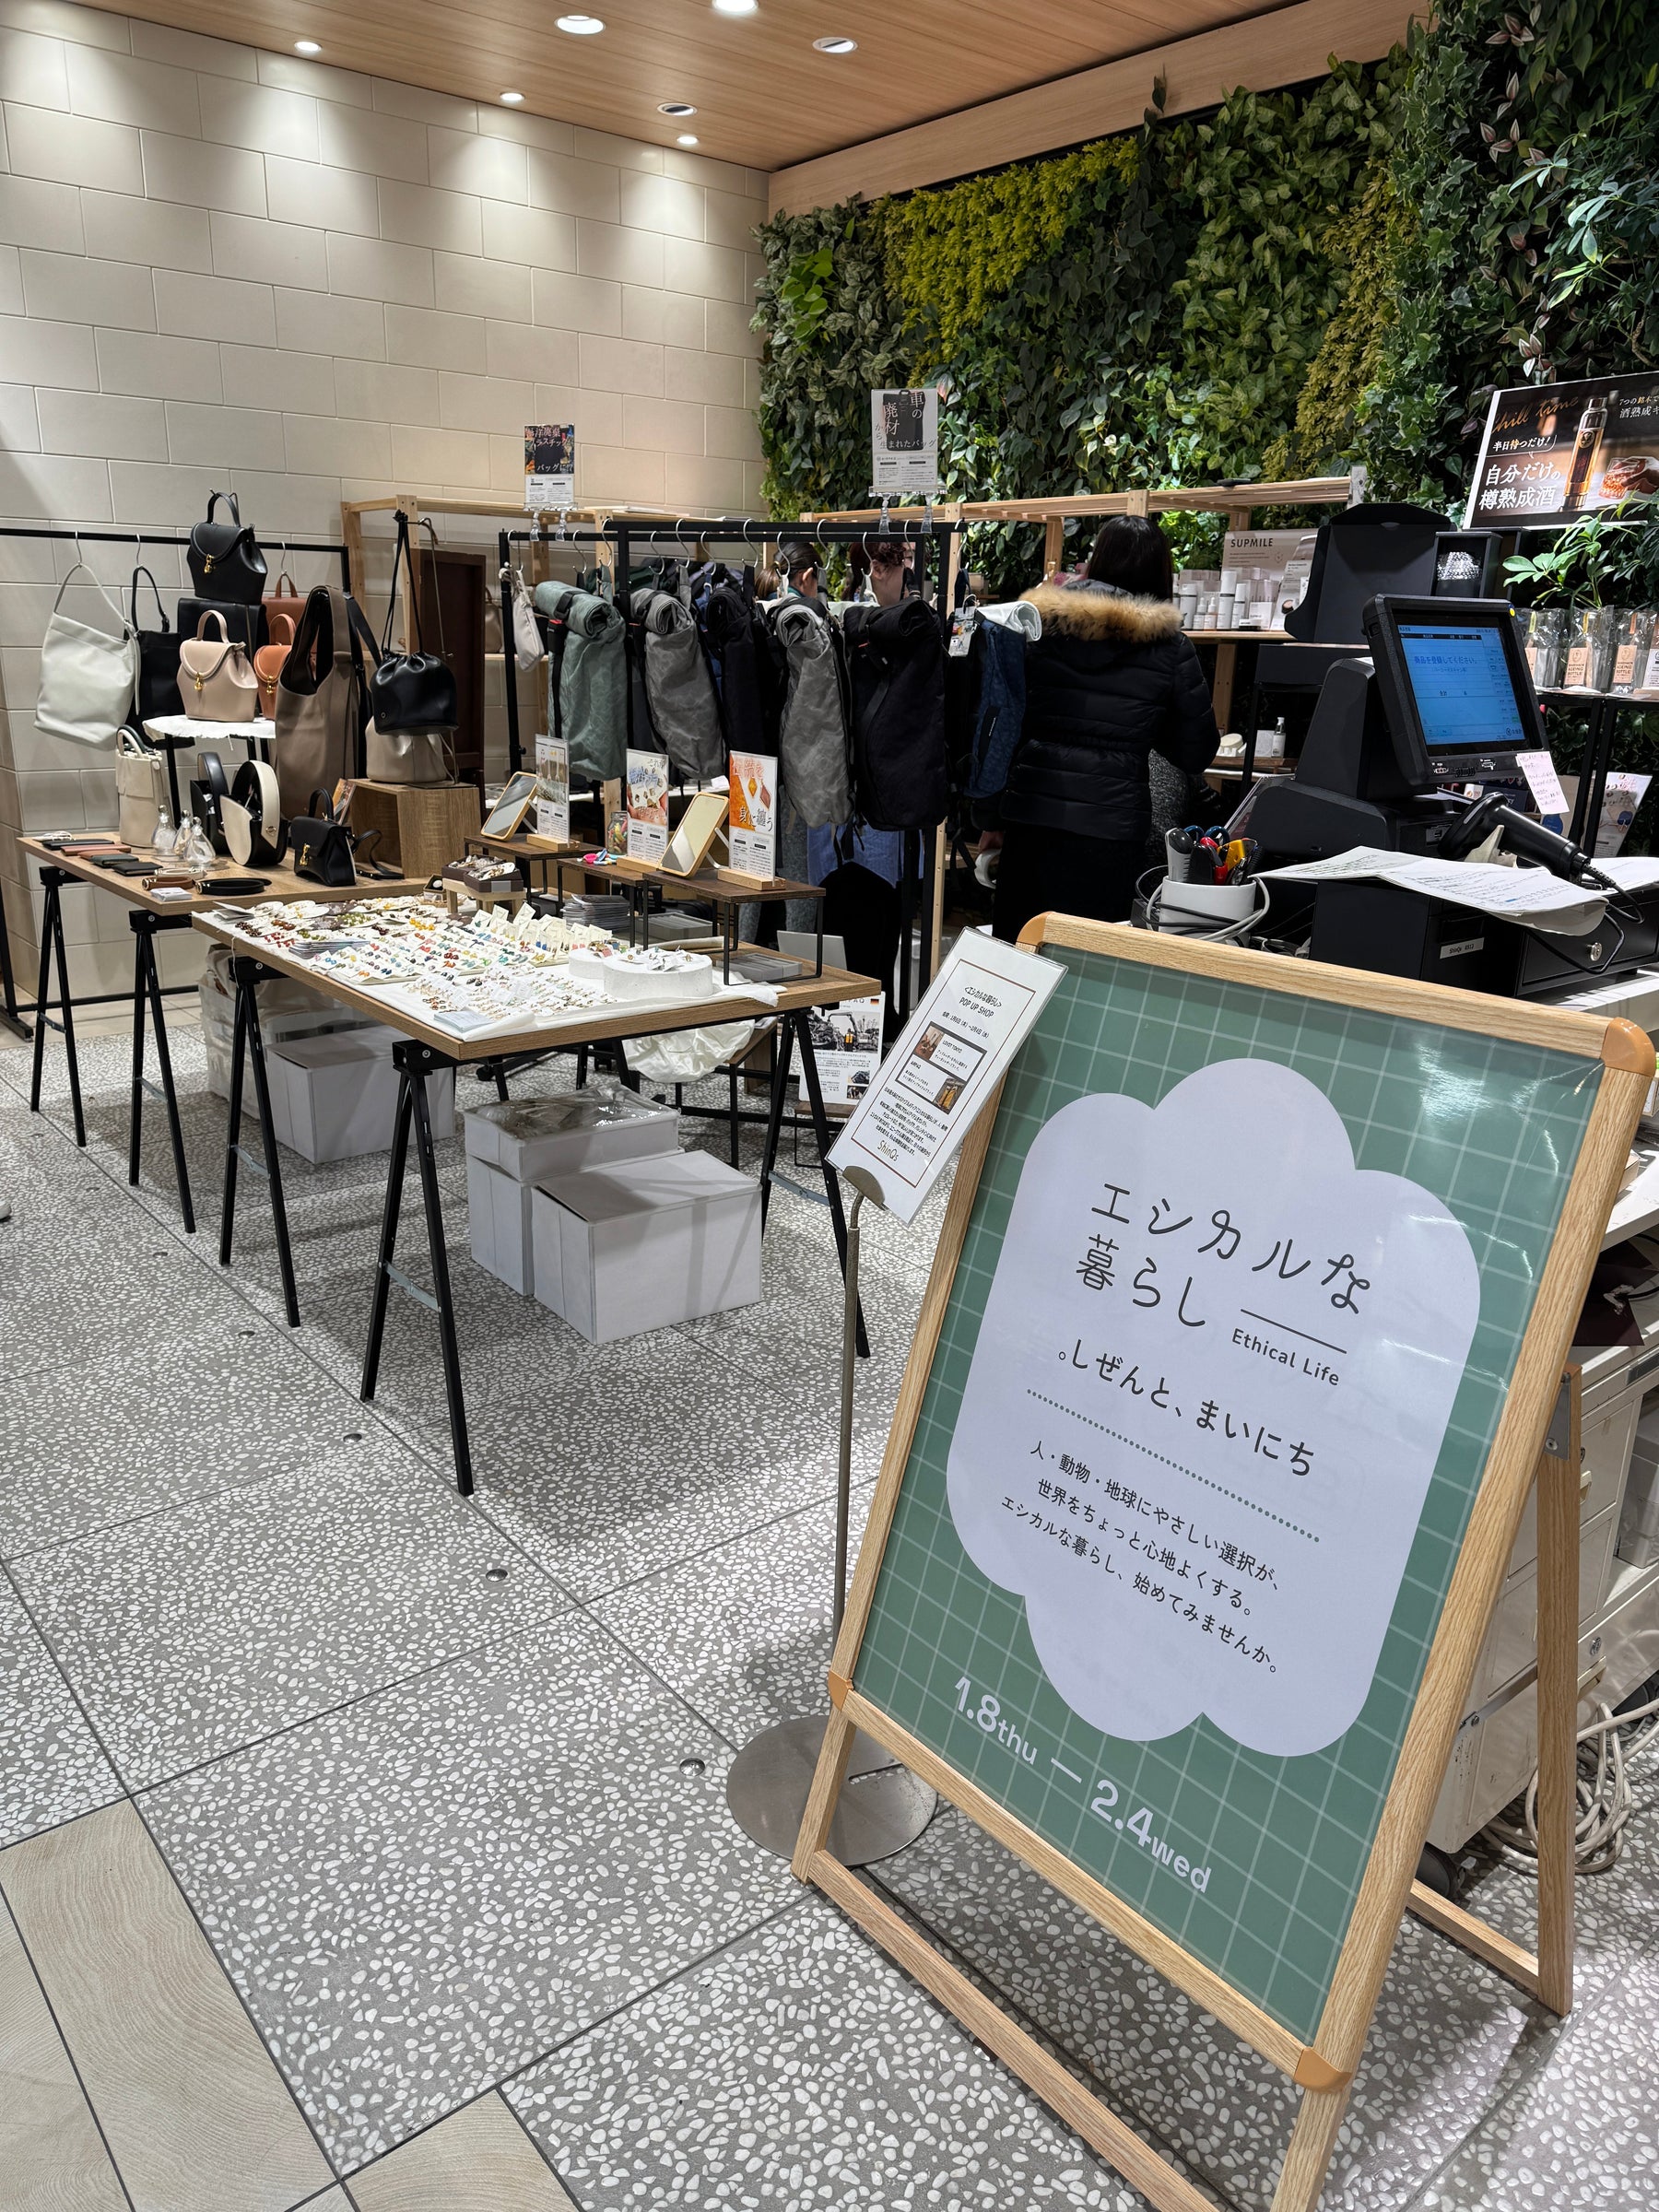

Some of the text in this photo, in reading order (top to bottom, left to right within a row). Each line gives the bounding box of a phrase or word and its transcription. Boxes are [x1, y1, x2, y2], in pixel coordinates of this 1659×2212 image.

[1478, 484, 1558, 511] 樽熟成酒
[1485, 462, 1561, 487] 自分だけの
[1230, 538, 1273, 547] SUPMILE
[959, 997, 994, 1018] POP UP SHOP
[1076, 1233, 1206, 1327] 暮らし
[1091, 1182, 1371, 1314] エシカルな
[1231, 1328, 1340, 1386] Ethical Life
[1030, 1440, 1278, 1591] 人・動物・地球にやさしい選択が、
[1037, 1478, 1251, 1617] 世界をちょっと心地よくする。
[1001, 1496, 1277, 1674] エシカルな暮らし、始めてみませんか。
[954, 1676, 1039, 1765] 1.8thu
[1089, 1779, 1212, 1894] 2.4wed
